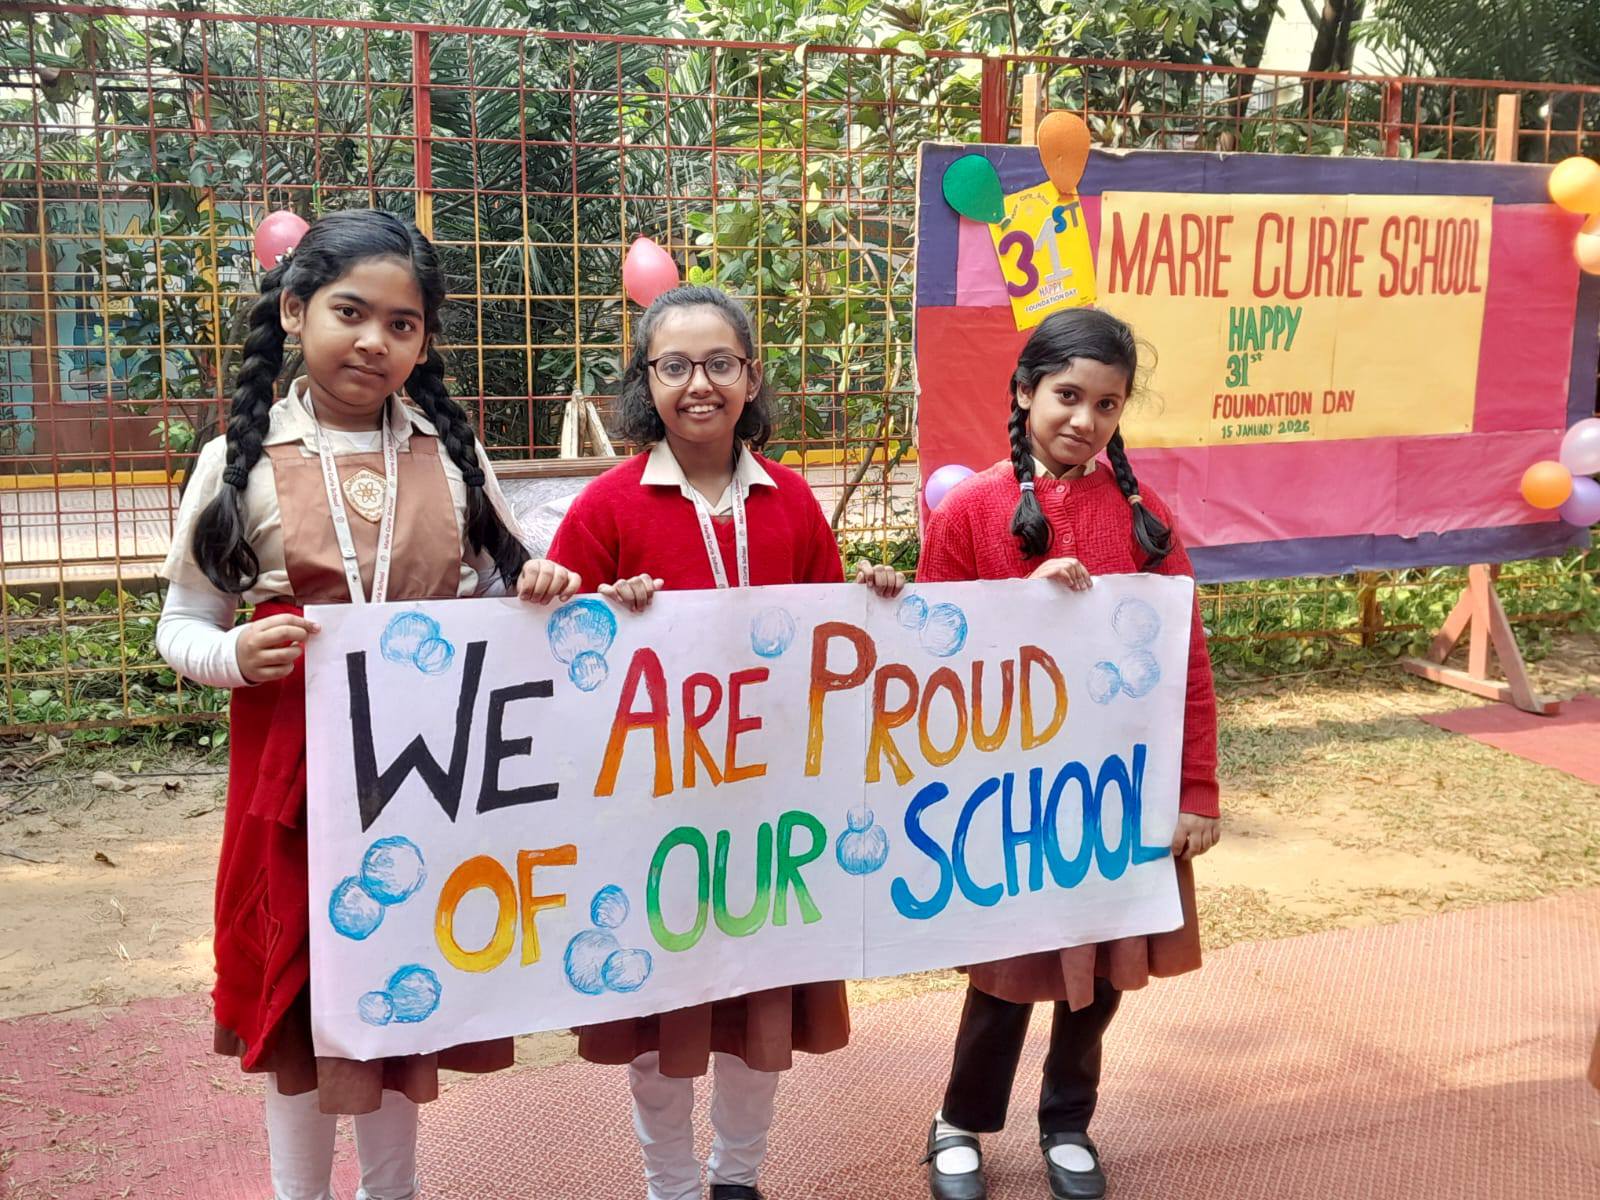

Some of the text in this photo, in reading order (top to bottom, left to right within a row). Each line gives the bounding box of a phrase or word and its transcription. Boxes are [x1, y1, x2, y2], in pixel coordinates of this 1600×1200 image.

[1108, 211, 1482, 300] MARIE CURIE SCHOOL
[1228, 305, 1303, 352] HAPPY
[1212, 390, 1356, 420] FOUNDATION DAY
[1221, 420, 1310, 439] 15 JANUARY 2026
[345, 621, 1069, 833] WE ARE PROUD
[434, 744, 1172, 973] OF OUR SCHOOL
